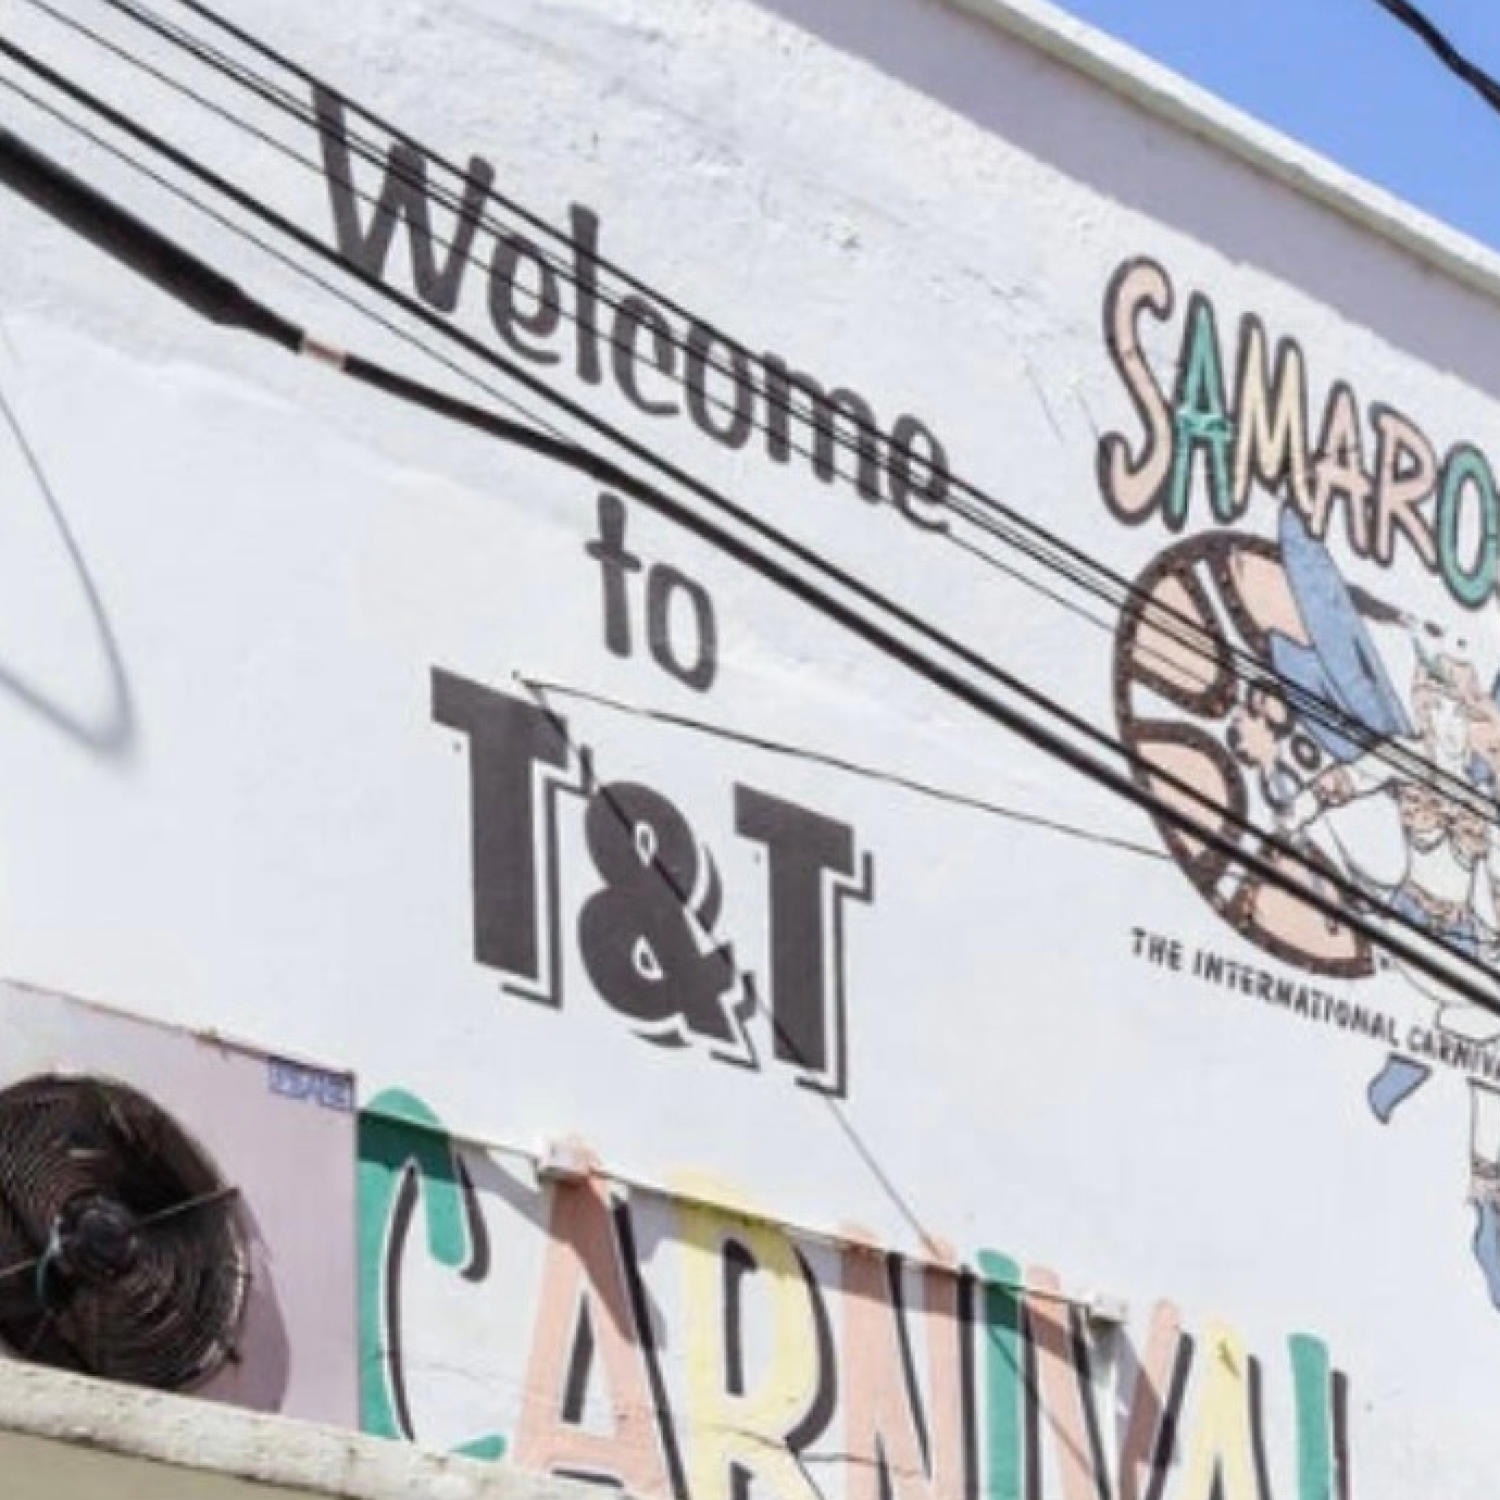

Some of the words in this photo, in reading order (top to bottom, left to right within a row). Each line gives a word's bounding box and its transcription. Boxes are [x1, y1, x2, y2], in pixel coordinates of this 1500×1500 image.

[312, 80, 951, 535] Welcome
[587, 492, 718, 692] to
[430, 666, 874, 1098] T&T
[1131, 927, 1183, 970] THE
[1193, 945, 1399, 1047] INTERNATIONAL
